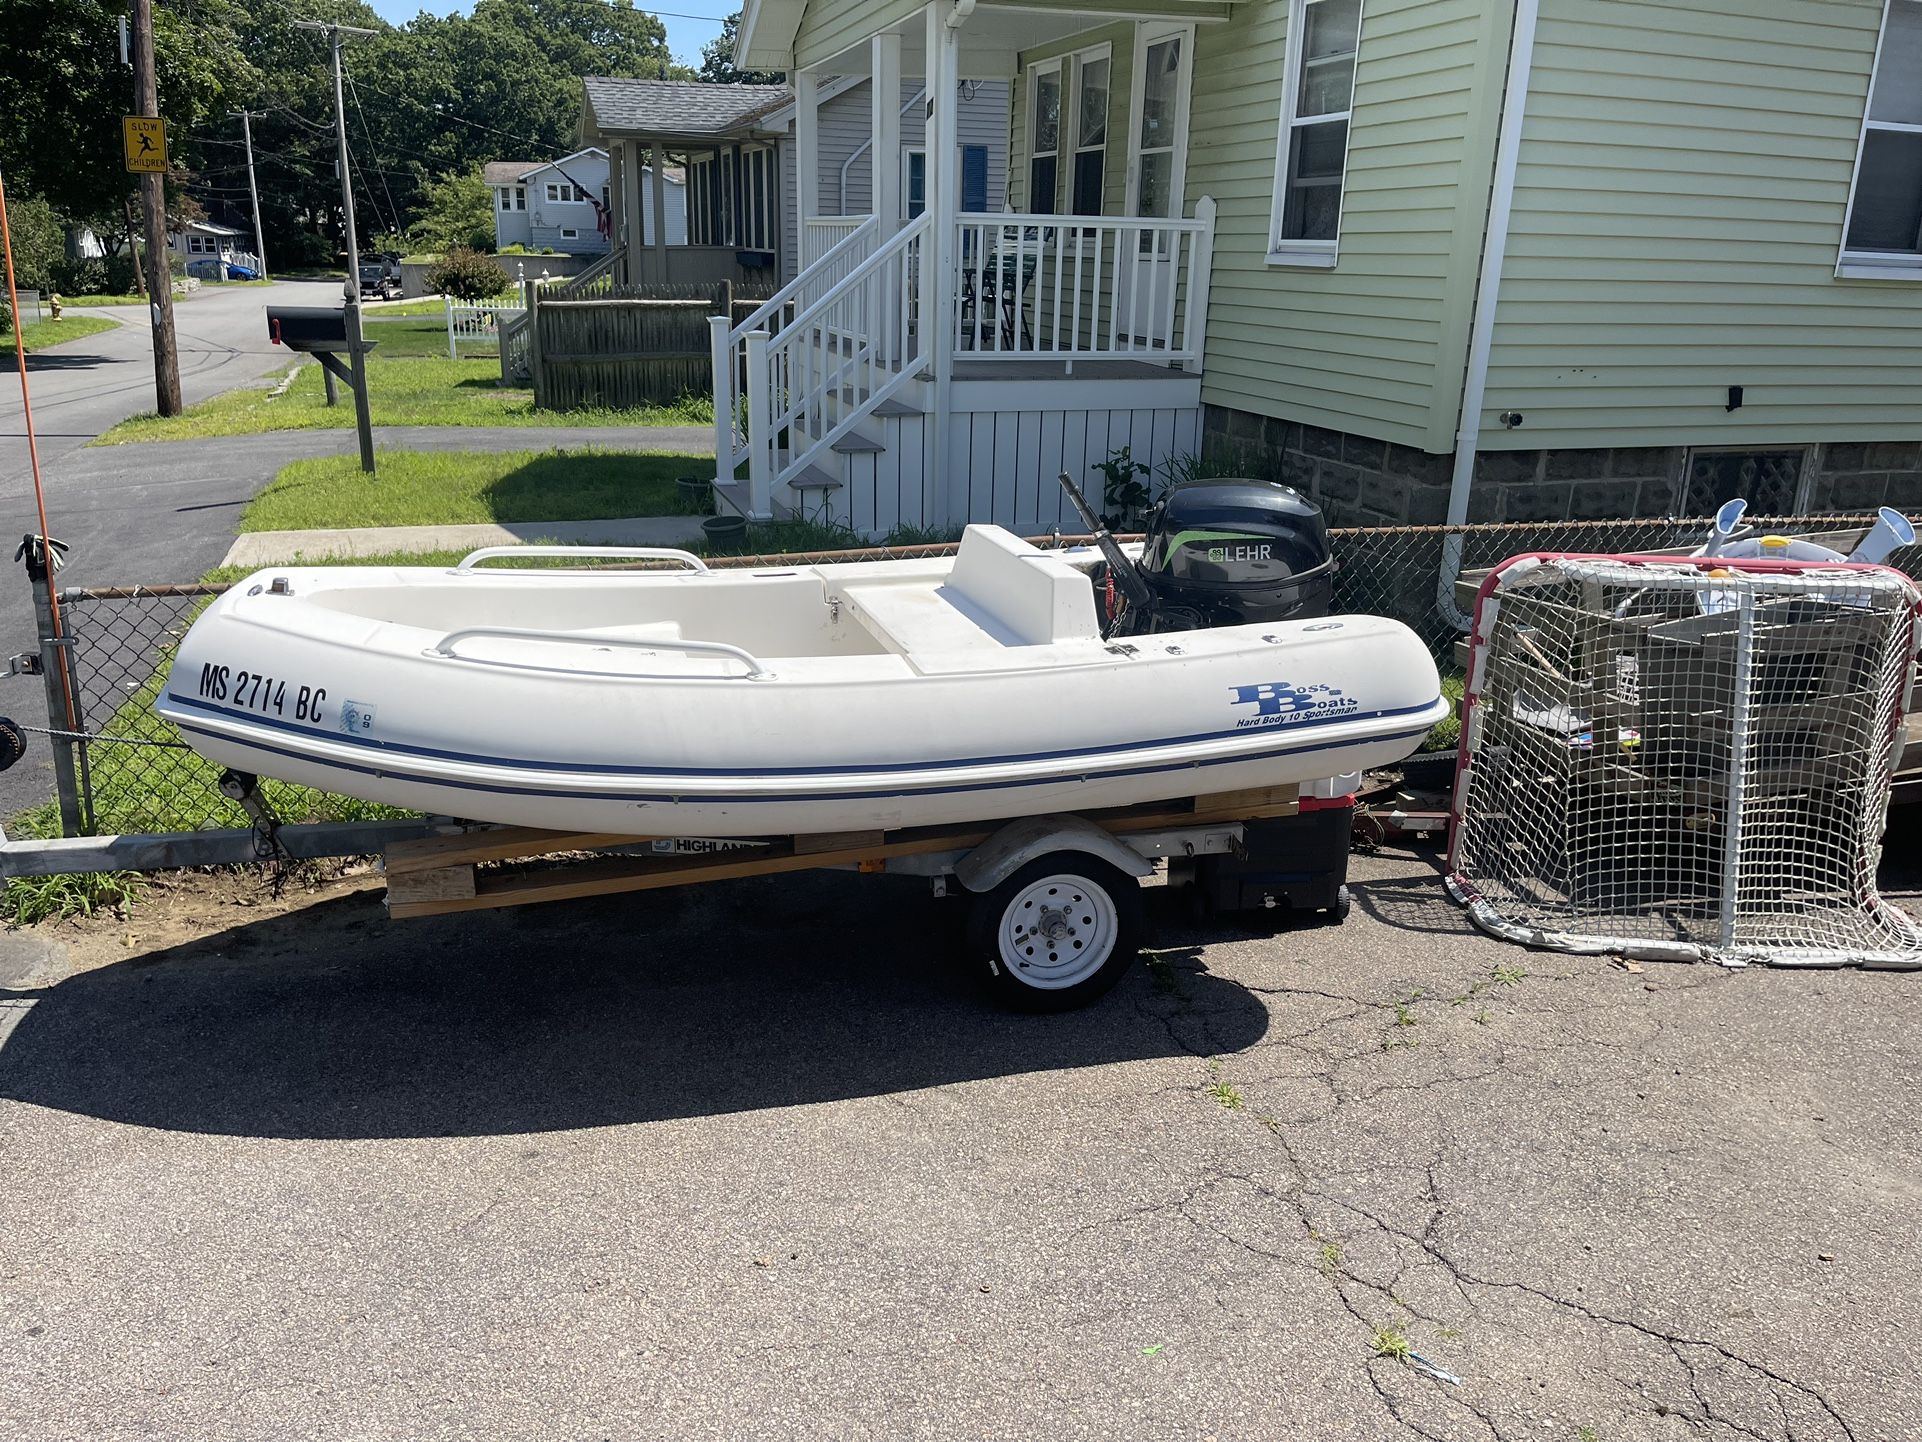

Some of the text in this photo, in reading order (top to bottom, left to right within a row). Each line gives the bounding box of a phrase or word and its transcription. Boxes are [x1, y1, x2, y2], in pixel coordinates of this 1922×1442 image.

[131, 122, 157, 131] SLOW
[129, 158, 165, 167] CHILDREN
[1225, 544, 1271, 561] LEHR
[199, 662, 327, 723] MS 2714 BC
[1228, 681, 1330, 704] Boss
[1252, 689, 1358, 716] Boats
[1236, 706, 1358, 727] Hard Body 10 Sportsman
[676, 839, 753, 852] HIGHLA
